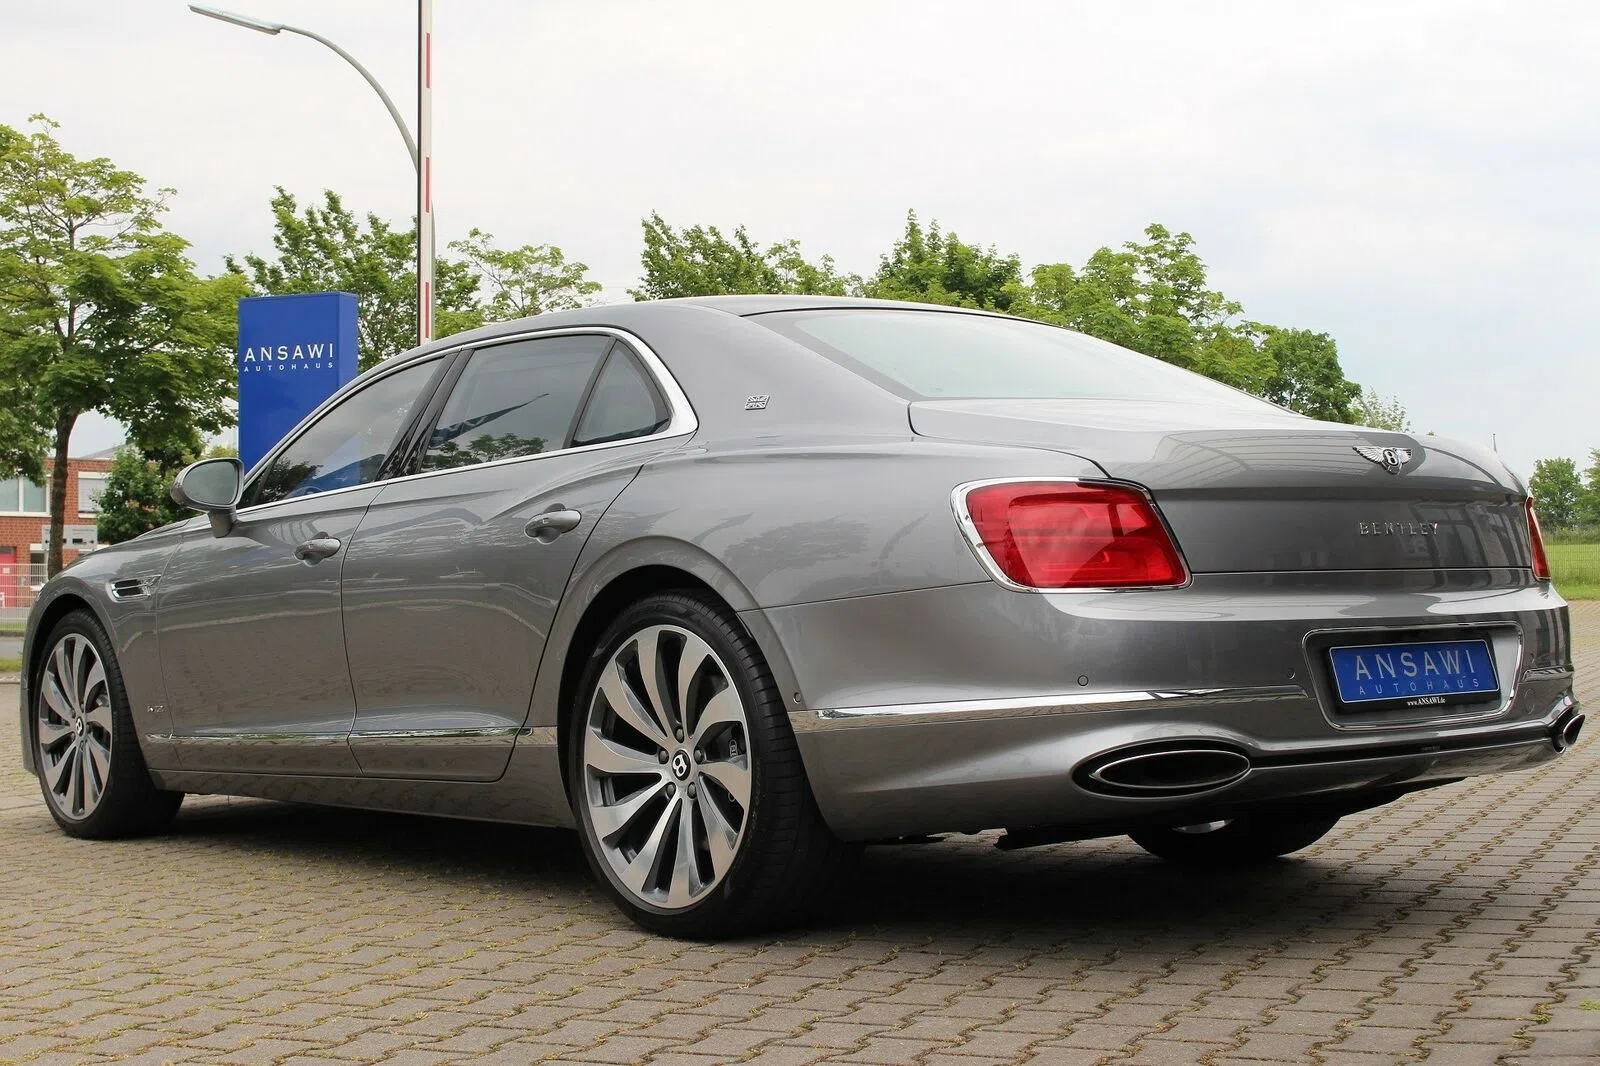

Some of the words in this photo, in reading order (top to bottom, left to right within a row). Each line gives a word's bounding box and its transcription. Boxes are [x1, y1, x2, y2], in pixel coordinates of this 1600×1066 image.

[244, 343, 333, 362] ANSAWI
[244, 362, 333, 372] AUTOHAUS
[1359, 522, 1438, 535] BENTLEY
[1356, 649, 1475, 681] ANSAWI
[1358, 678, 1480, 696] AUTOHAUS
